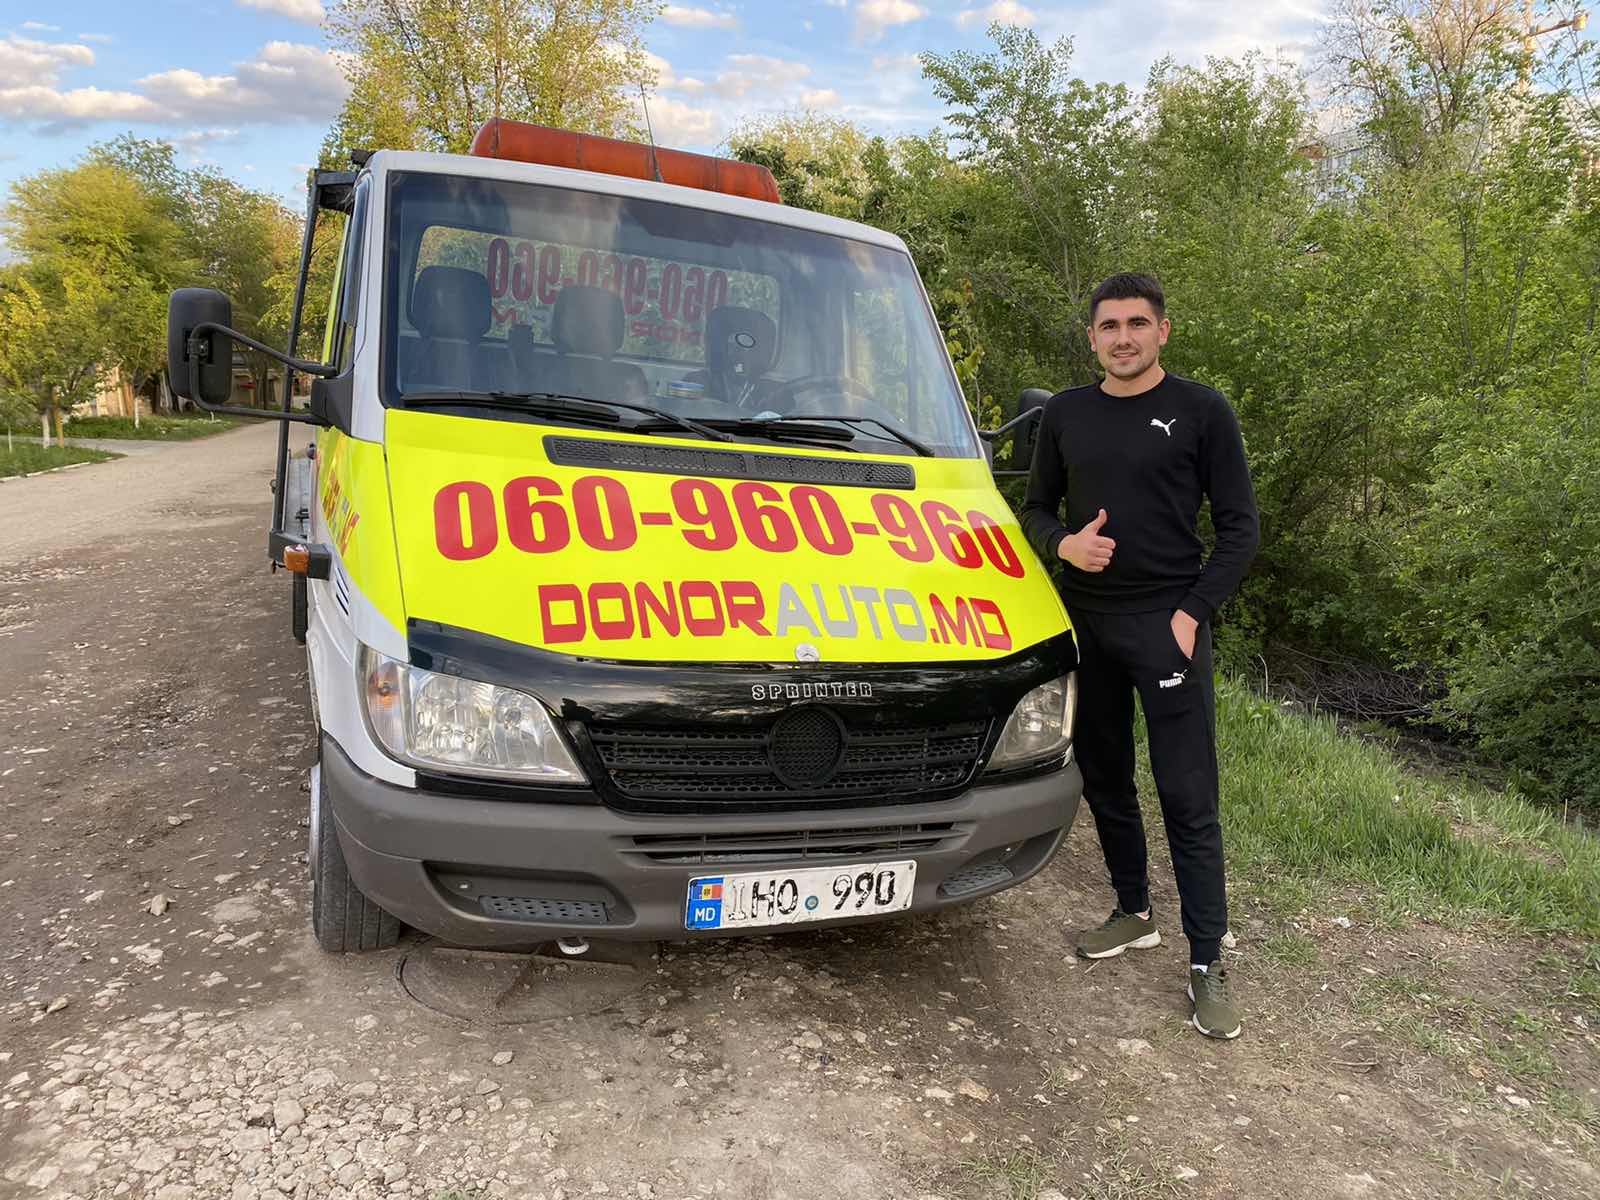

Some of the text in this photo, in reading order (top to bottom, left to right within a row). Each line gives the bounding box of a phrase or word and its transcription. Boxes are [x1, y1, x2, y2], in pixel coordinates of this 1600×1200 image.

[433, 475, 1025, 579] 060-960-960
[538, 580, 1013, 651] DONORAUTO.MD
[751, 682, 873, 701] SPRINTER
[832, 870, 896, 911] 990
[694, 907, 716, 922] MD
